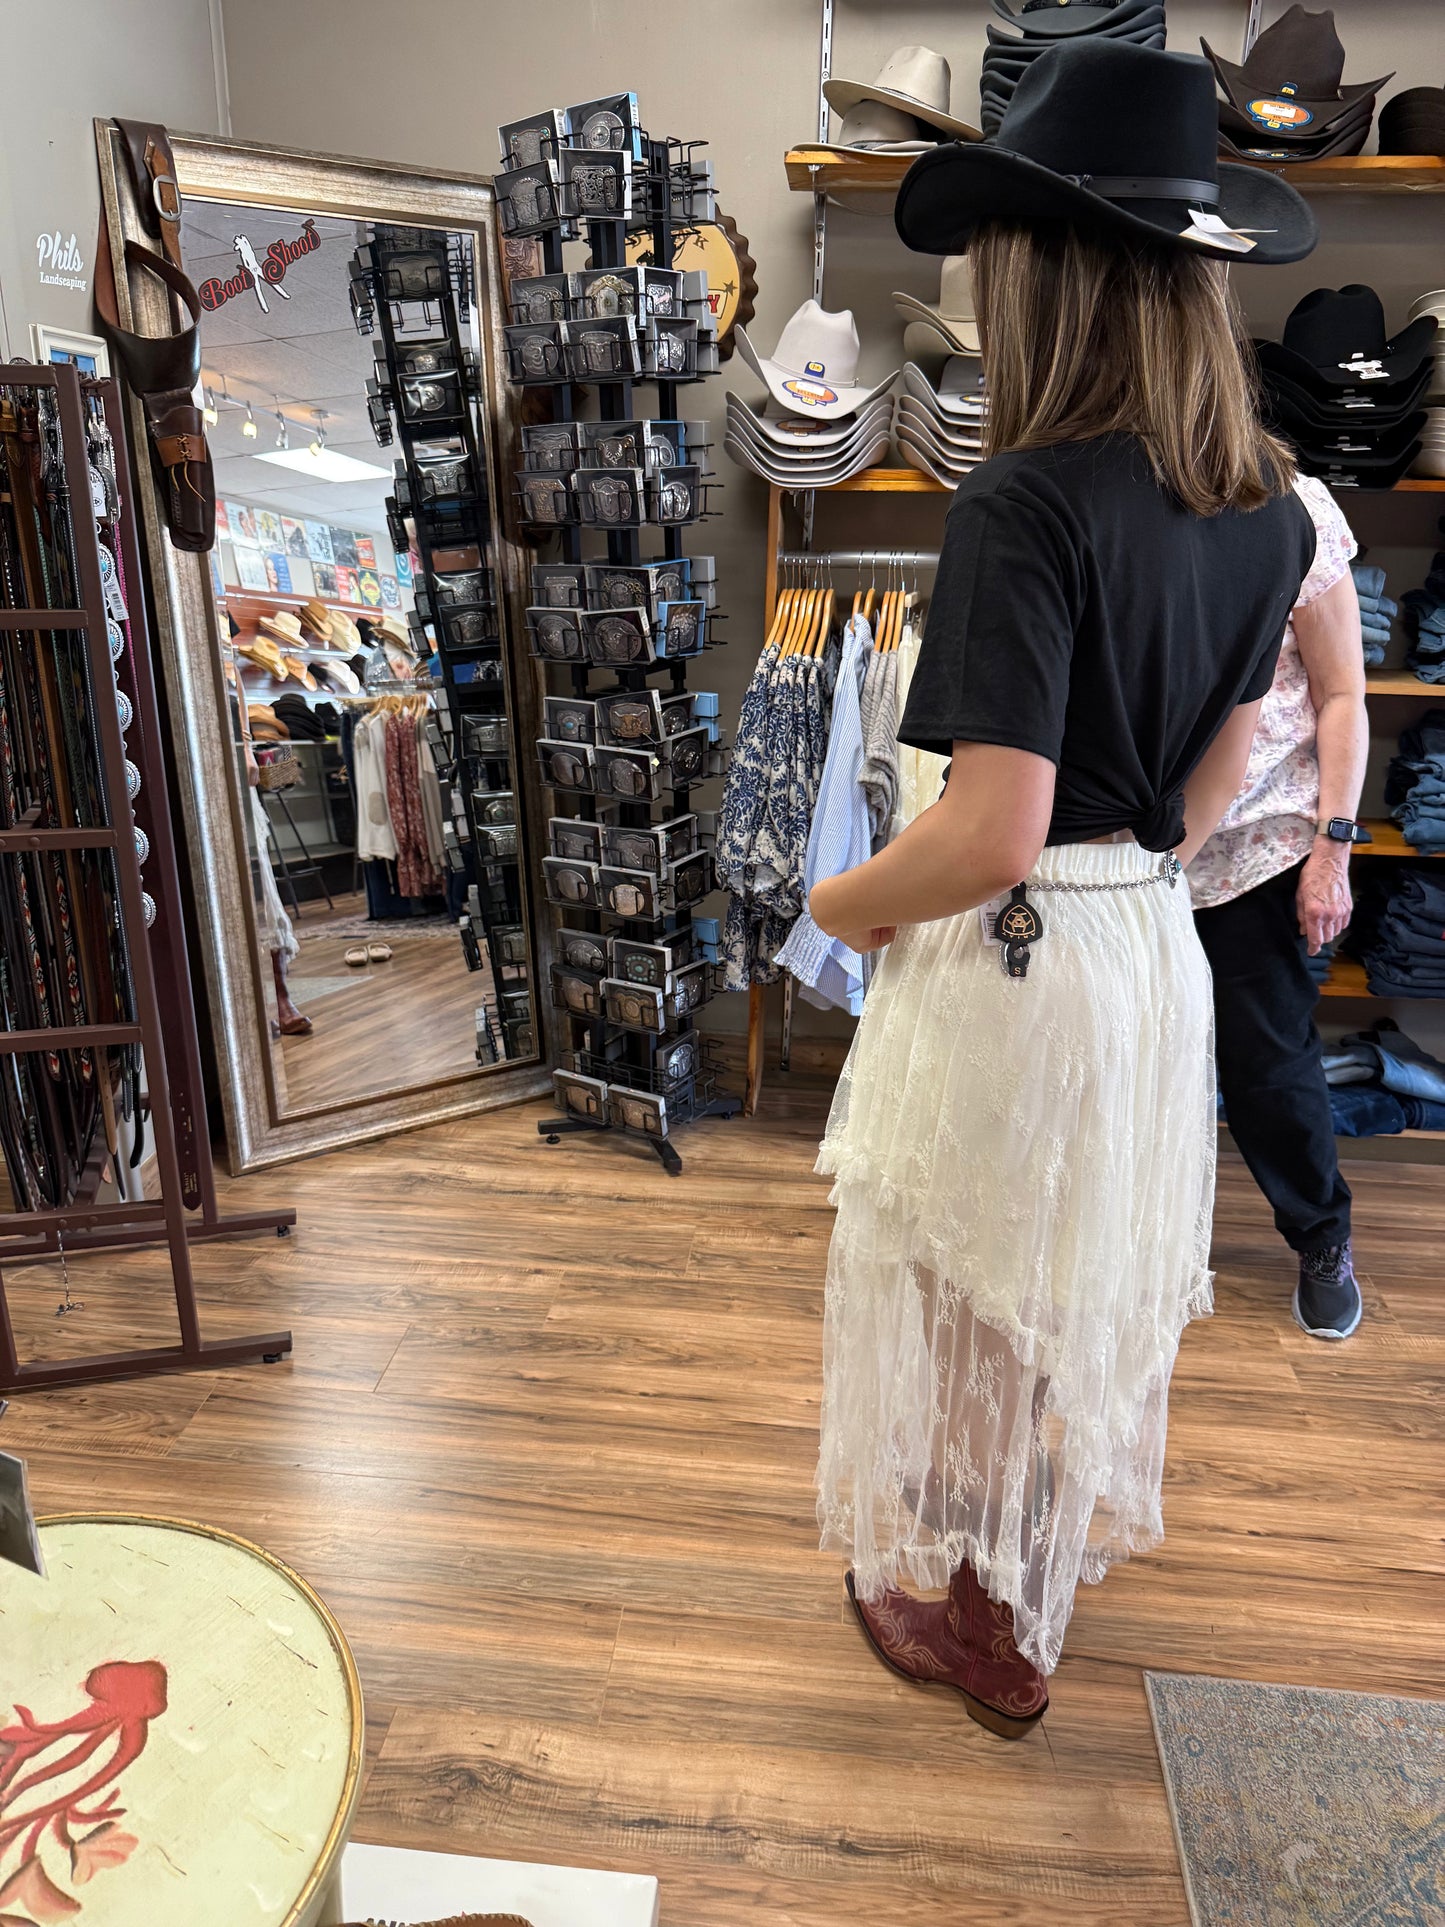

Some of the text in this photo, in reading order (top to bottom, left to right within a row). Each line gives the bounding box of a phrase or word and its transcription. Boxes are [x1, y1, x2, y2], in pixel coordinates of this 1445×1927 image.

[36, 231, 84, 272] Phils
[199, 219, 321, 311] Boot Shoot
[39, 271, 87, 292] Landscaping
